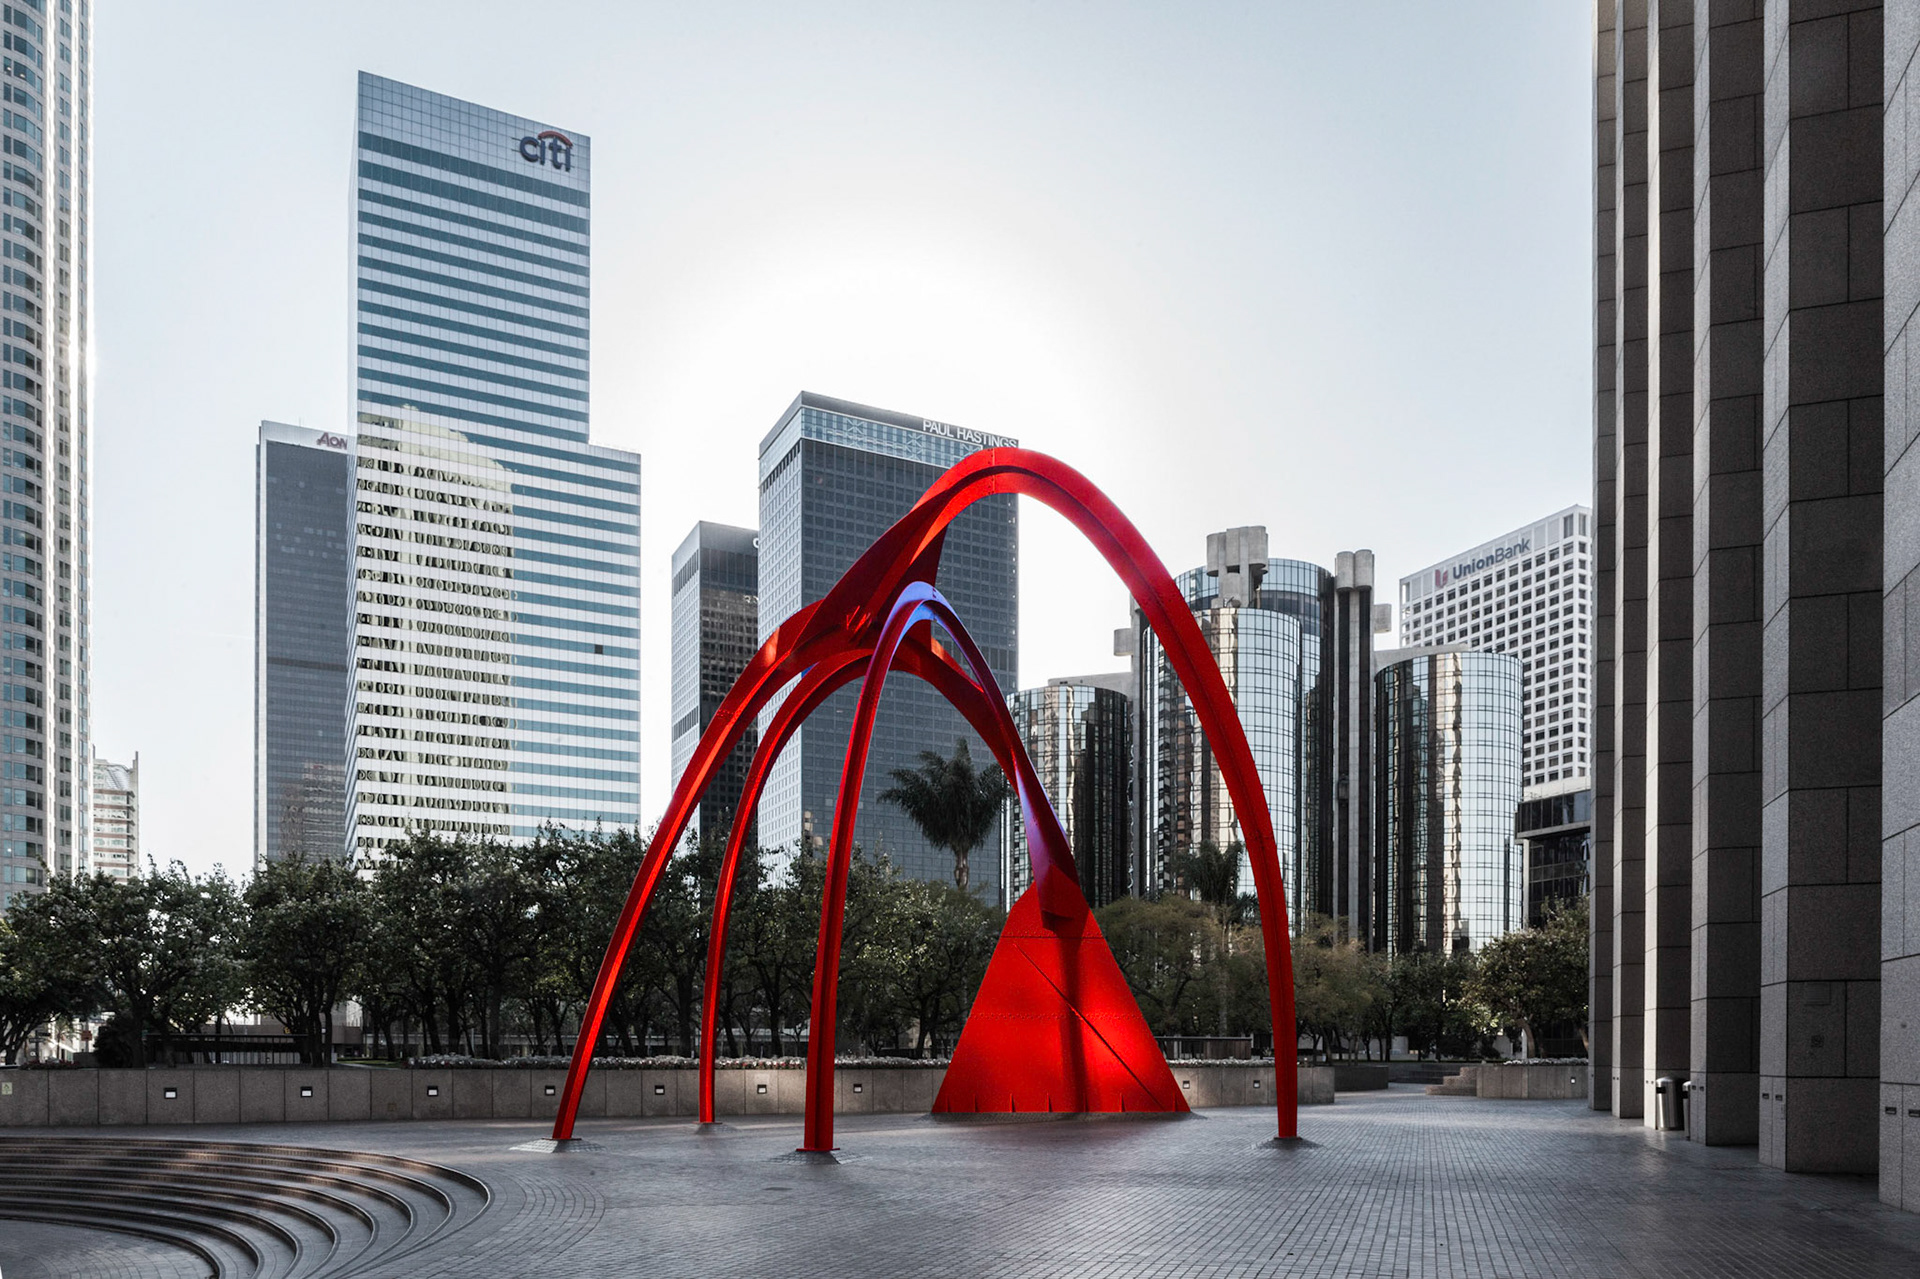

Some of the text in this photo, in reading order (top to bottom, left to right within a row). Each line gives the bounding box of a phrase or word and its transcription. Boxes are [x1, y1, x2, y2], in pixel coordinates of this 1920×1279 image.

[519, 134, 571, 172] citi
[922, 419, 1017, 448] PAUL HASTINGS
[1452, 538, 1531, 579] UnionBank
